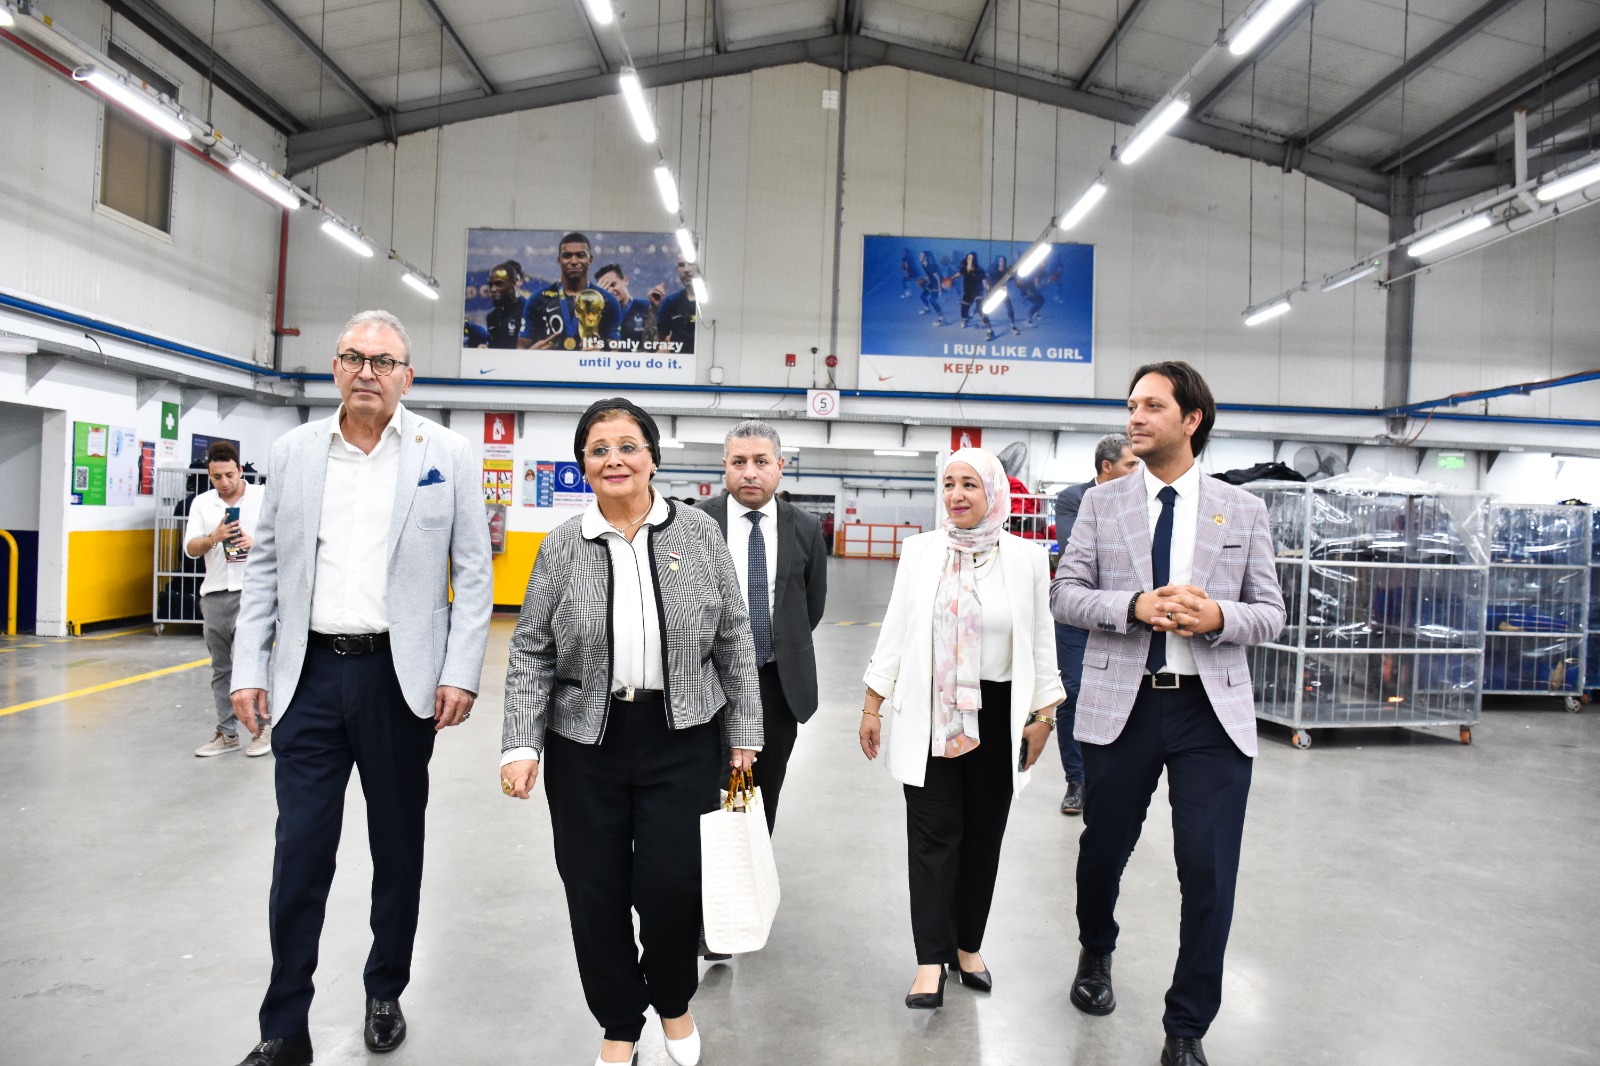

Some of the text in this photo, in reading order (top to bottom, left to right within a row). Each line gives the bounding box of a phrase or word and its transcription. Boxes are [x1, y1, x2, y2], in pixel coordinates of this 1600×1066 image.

[542, 314, 564, 335] 10
[582, 337, 684, 353] It's only crazy
[943, 343, 1083, 360] I RUN LIKE A GIRL
[579, 357, 682, 370] until you do it.
[943, 363, 1010, 375] KEEP UP
[820, 397, 827, 409] 5
